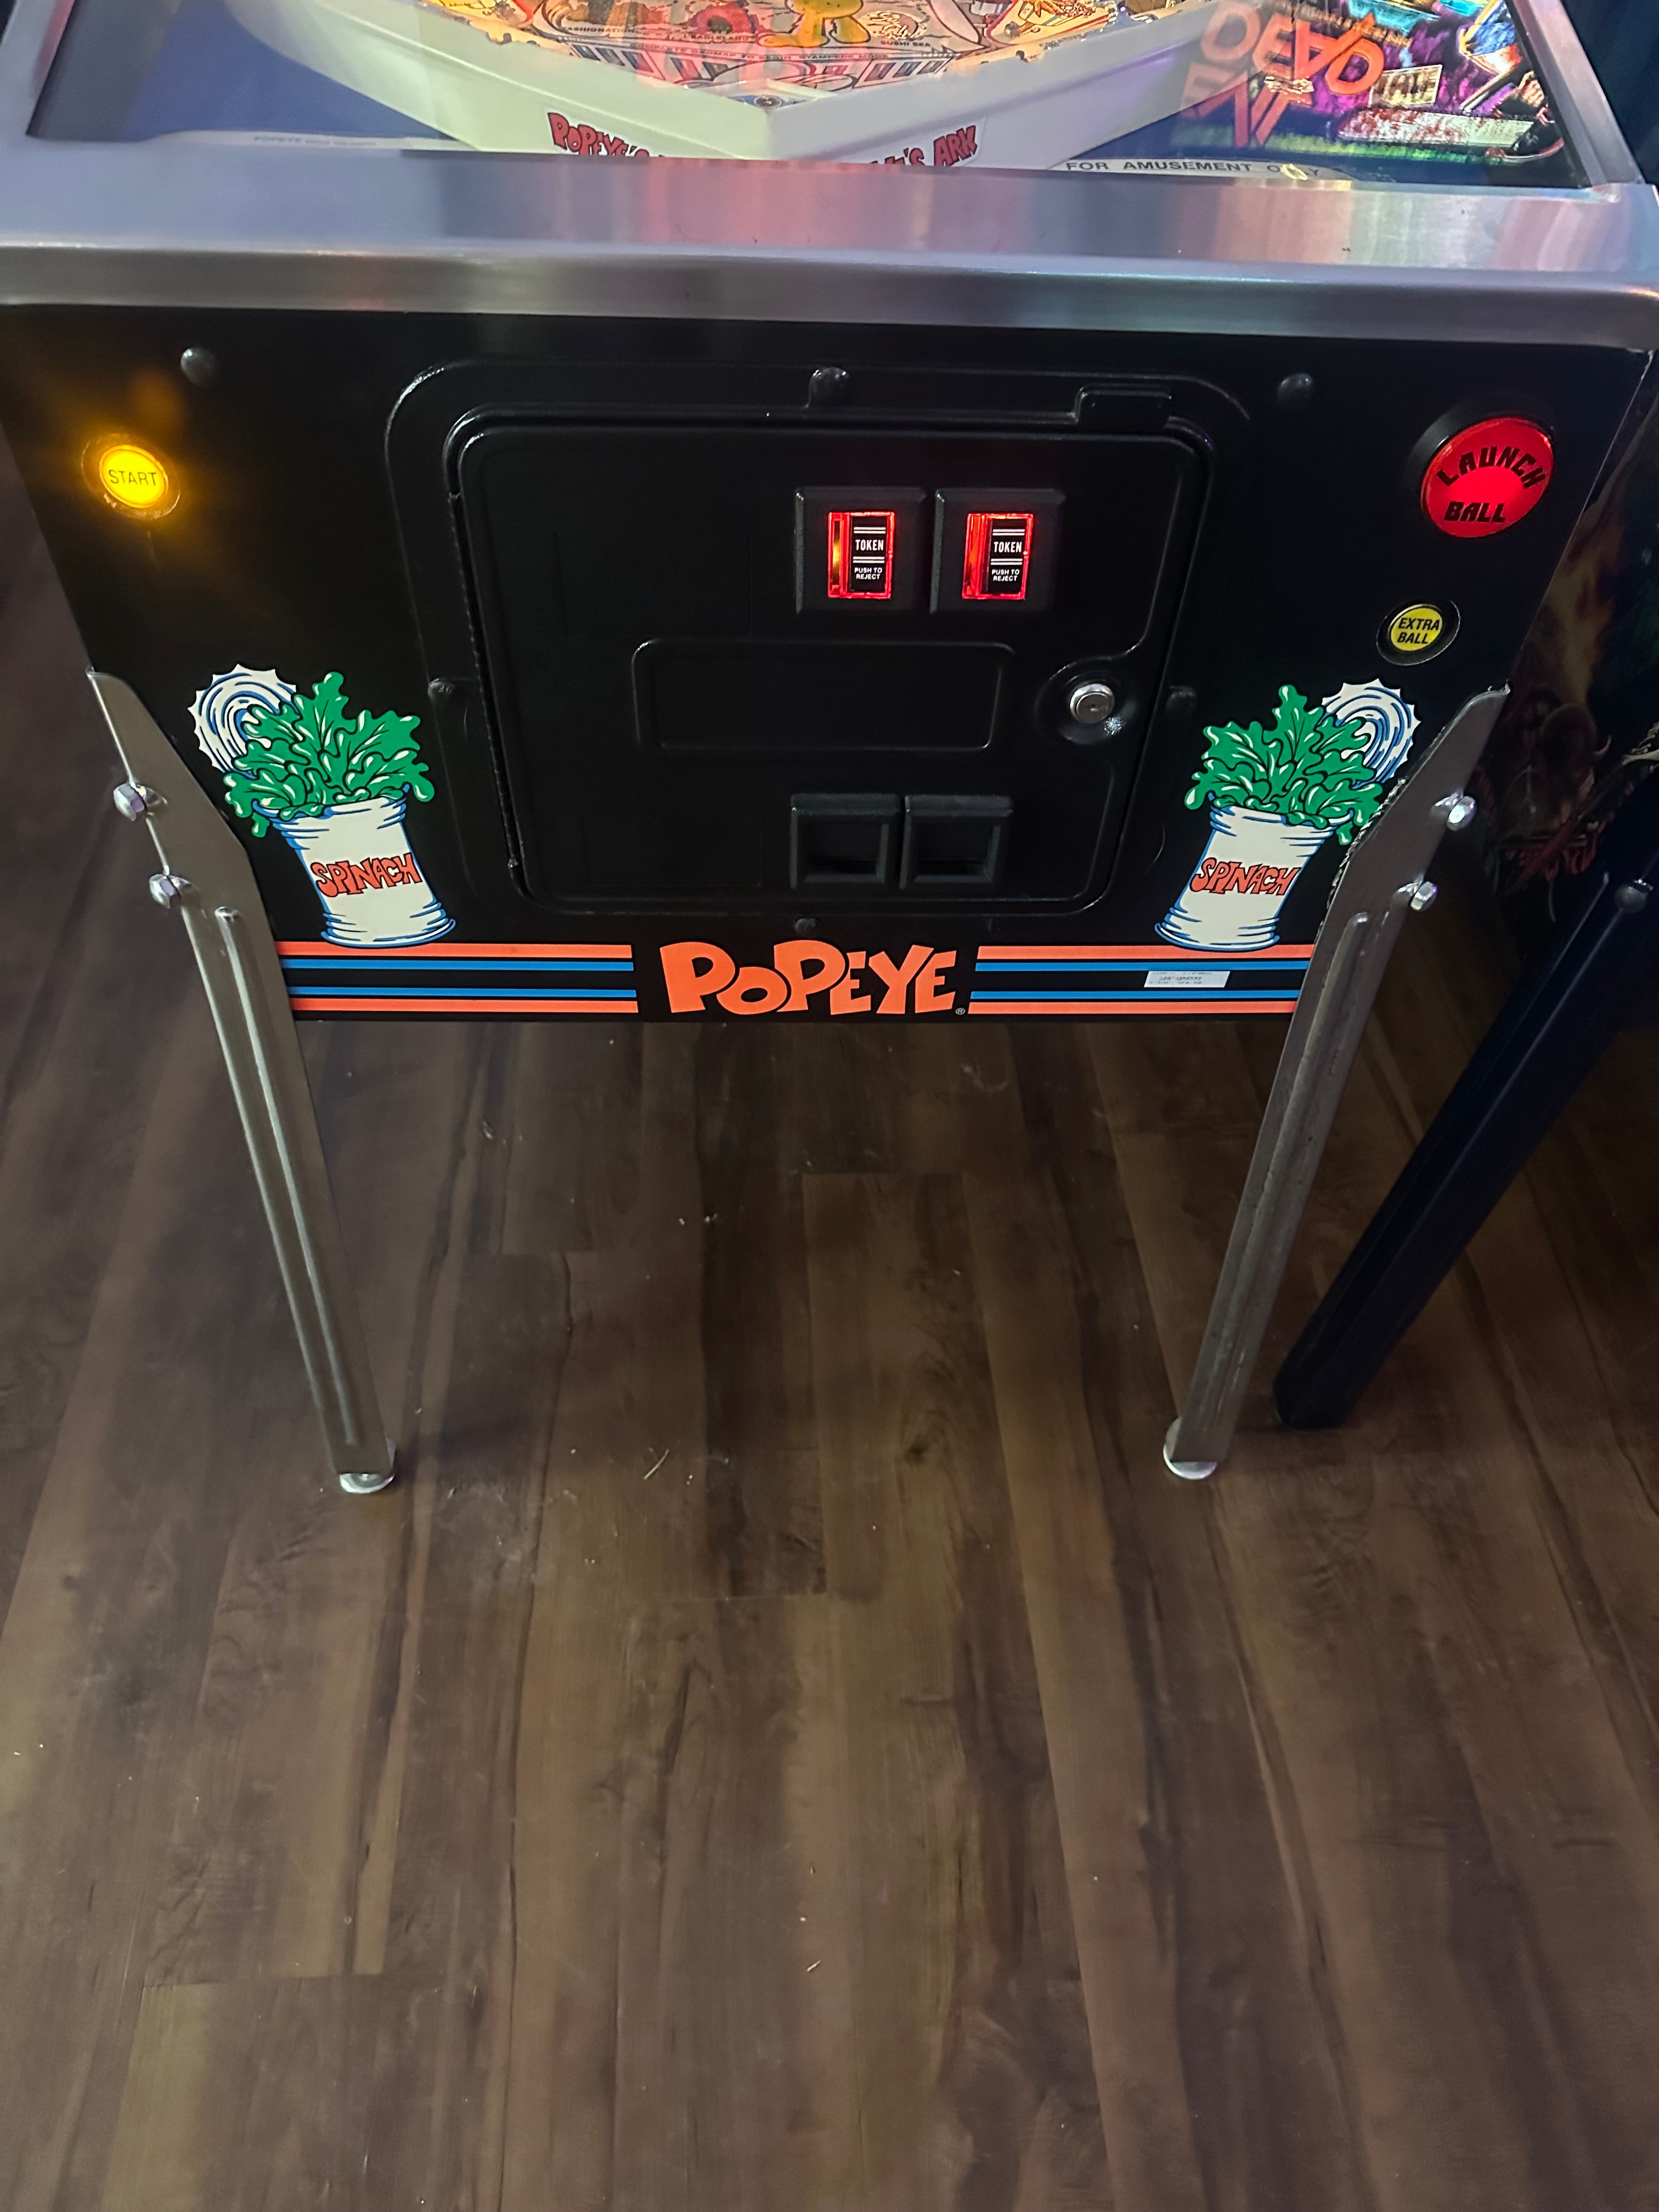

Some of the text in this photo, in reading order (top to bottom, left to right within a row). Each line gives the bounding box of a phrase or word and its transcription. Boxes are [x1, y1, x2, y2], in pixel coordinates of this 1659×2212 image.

[933, 125, 978, 167] ARK
[1066, 162, 1109, 170] FOR
[1123, 161, 1252, 172] AMUSEMENT
[1436, 445, 1547, 489] LAUNCH
[108, 469, 157, 487] START
[1443, 501, 1506, 523] BALL
[855, 539, 884, 551] TOKEN
[993, 541, 1023, 553] TOKEN
[1398, 617, 1440, 631] EXTRA
[1397, 631, 1429, 645] BALL
[310, 852, 422, 898] SPINACH
[1189, 857, 1302, 896] SPINACH
[659, 939, 957, 1015] POPEYE
